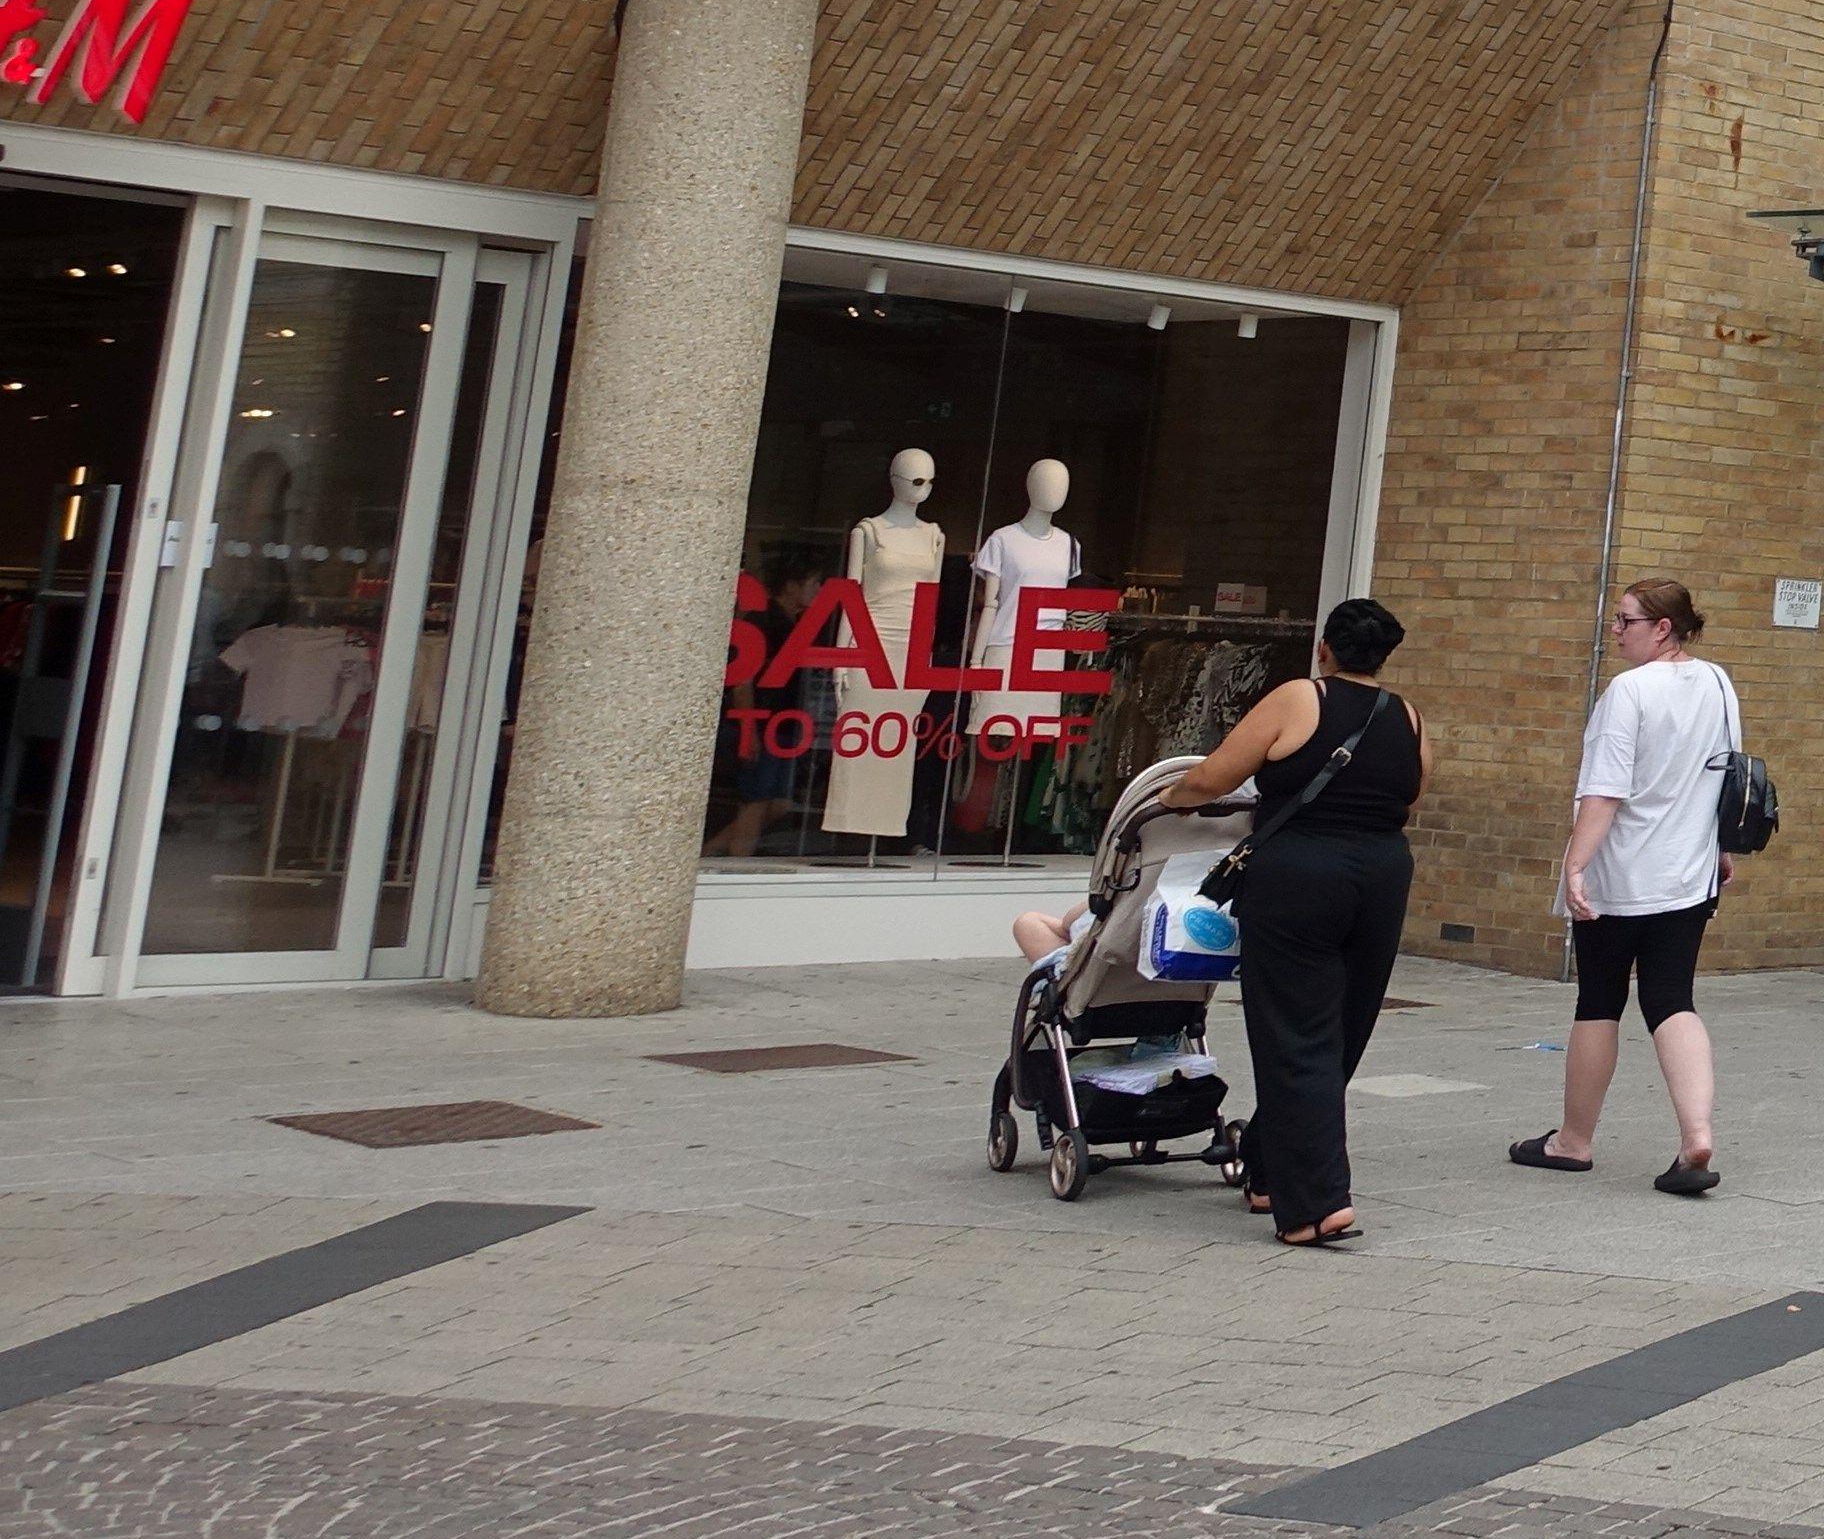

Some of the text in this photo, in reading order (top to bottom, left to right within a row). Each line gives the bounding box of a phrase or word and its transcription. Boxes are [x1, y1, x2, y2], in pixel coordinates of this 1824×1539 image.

[1779, 591, 1797, 602] STOP
[1780, 581, 1818, 593] SPRINKLER
[724, 569, 1122, 695] SALE
[726, 709, 1095, 762] TO 60% OFF
